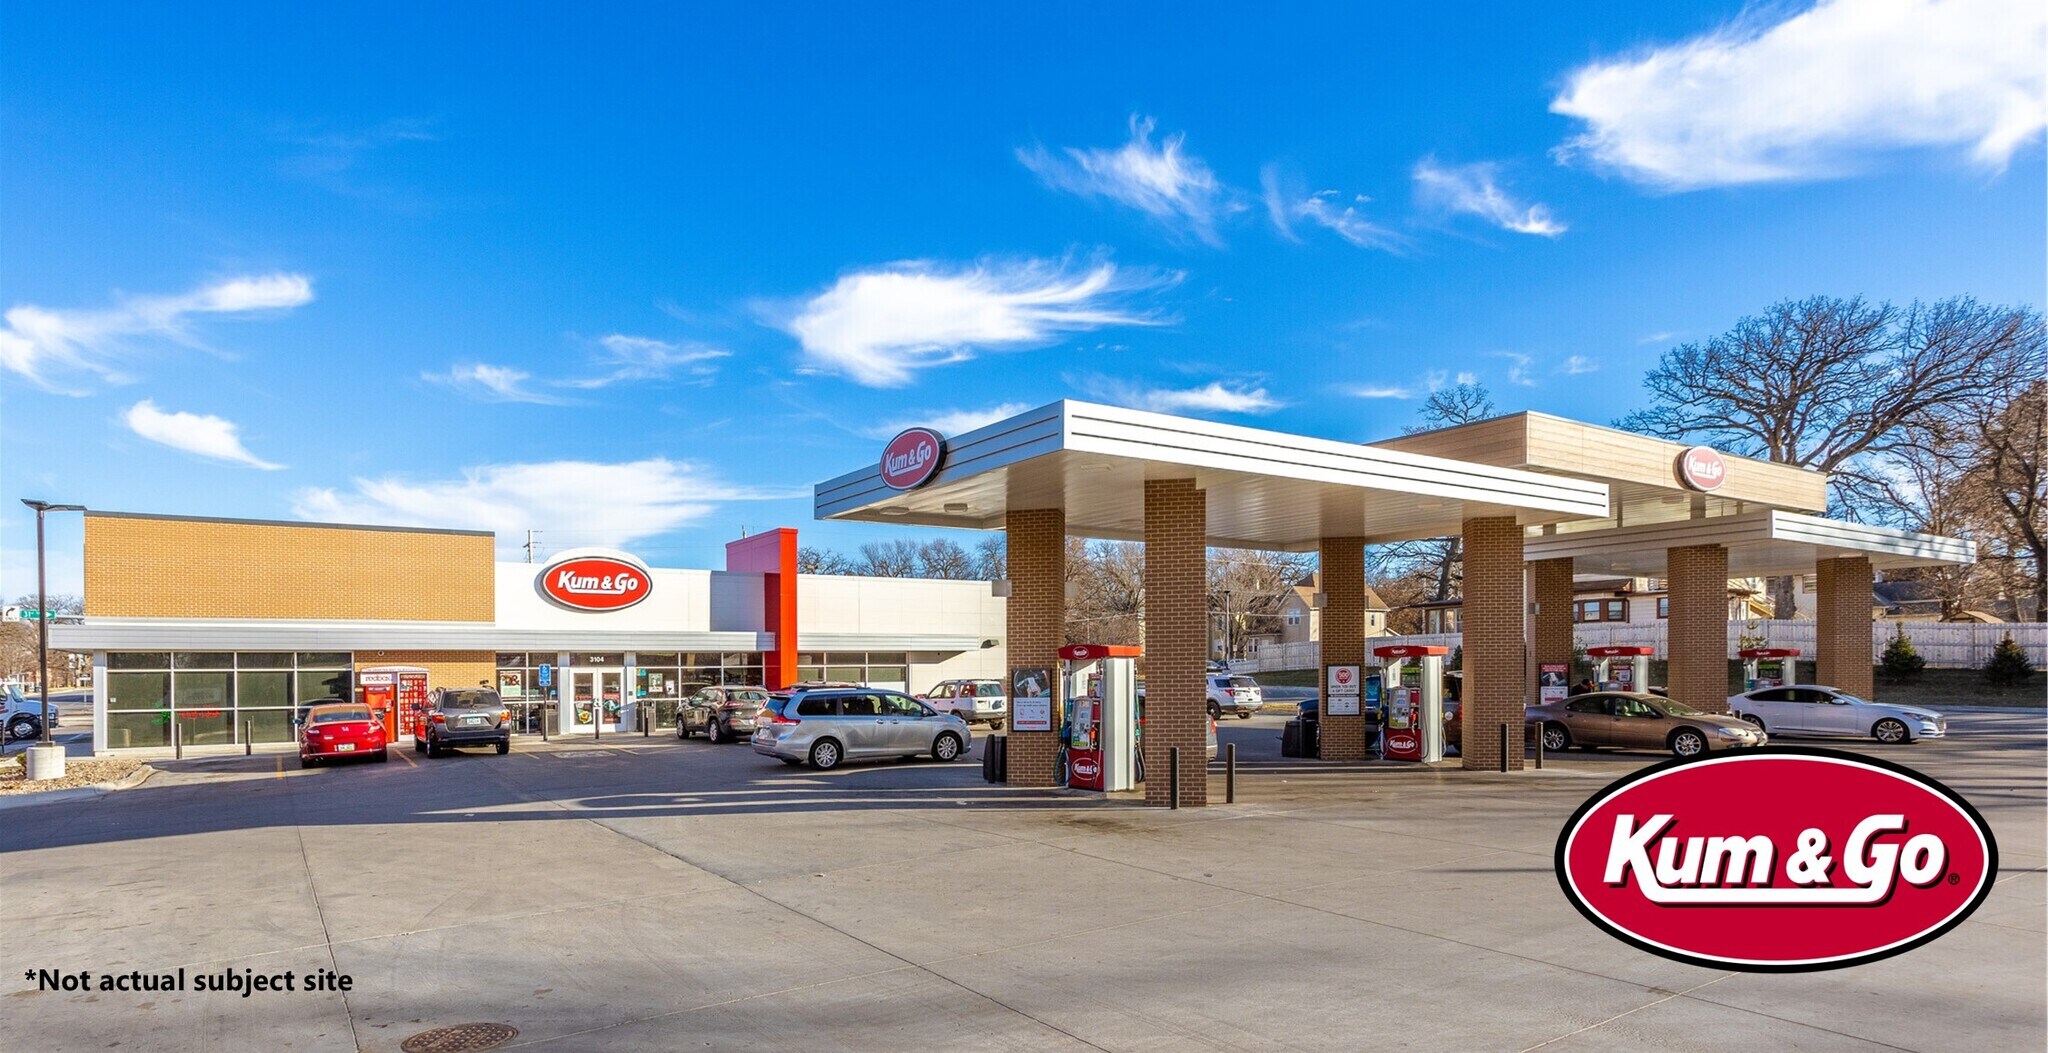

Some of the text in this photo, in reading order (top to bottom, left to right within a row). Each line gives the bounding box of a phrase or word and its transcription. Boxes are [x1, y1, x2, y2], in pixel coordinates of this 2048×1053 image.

[885, 440, 932, 476] Kum & Go
[557, 570, 639, 595] Kum & Go
